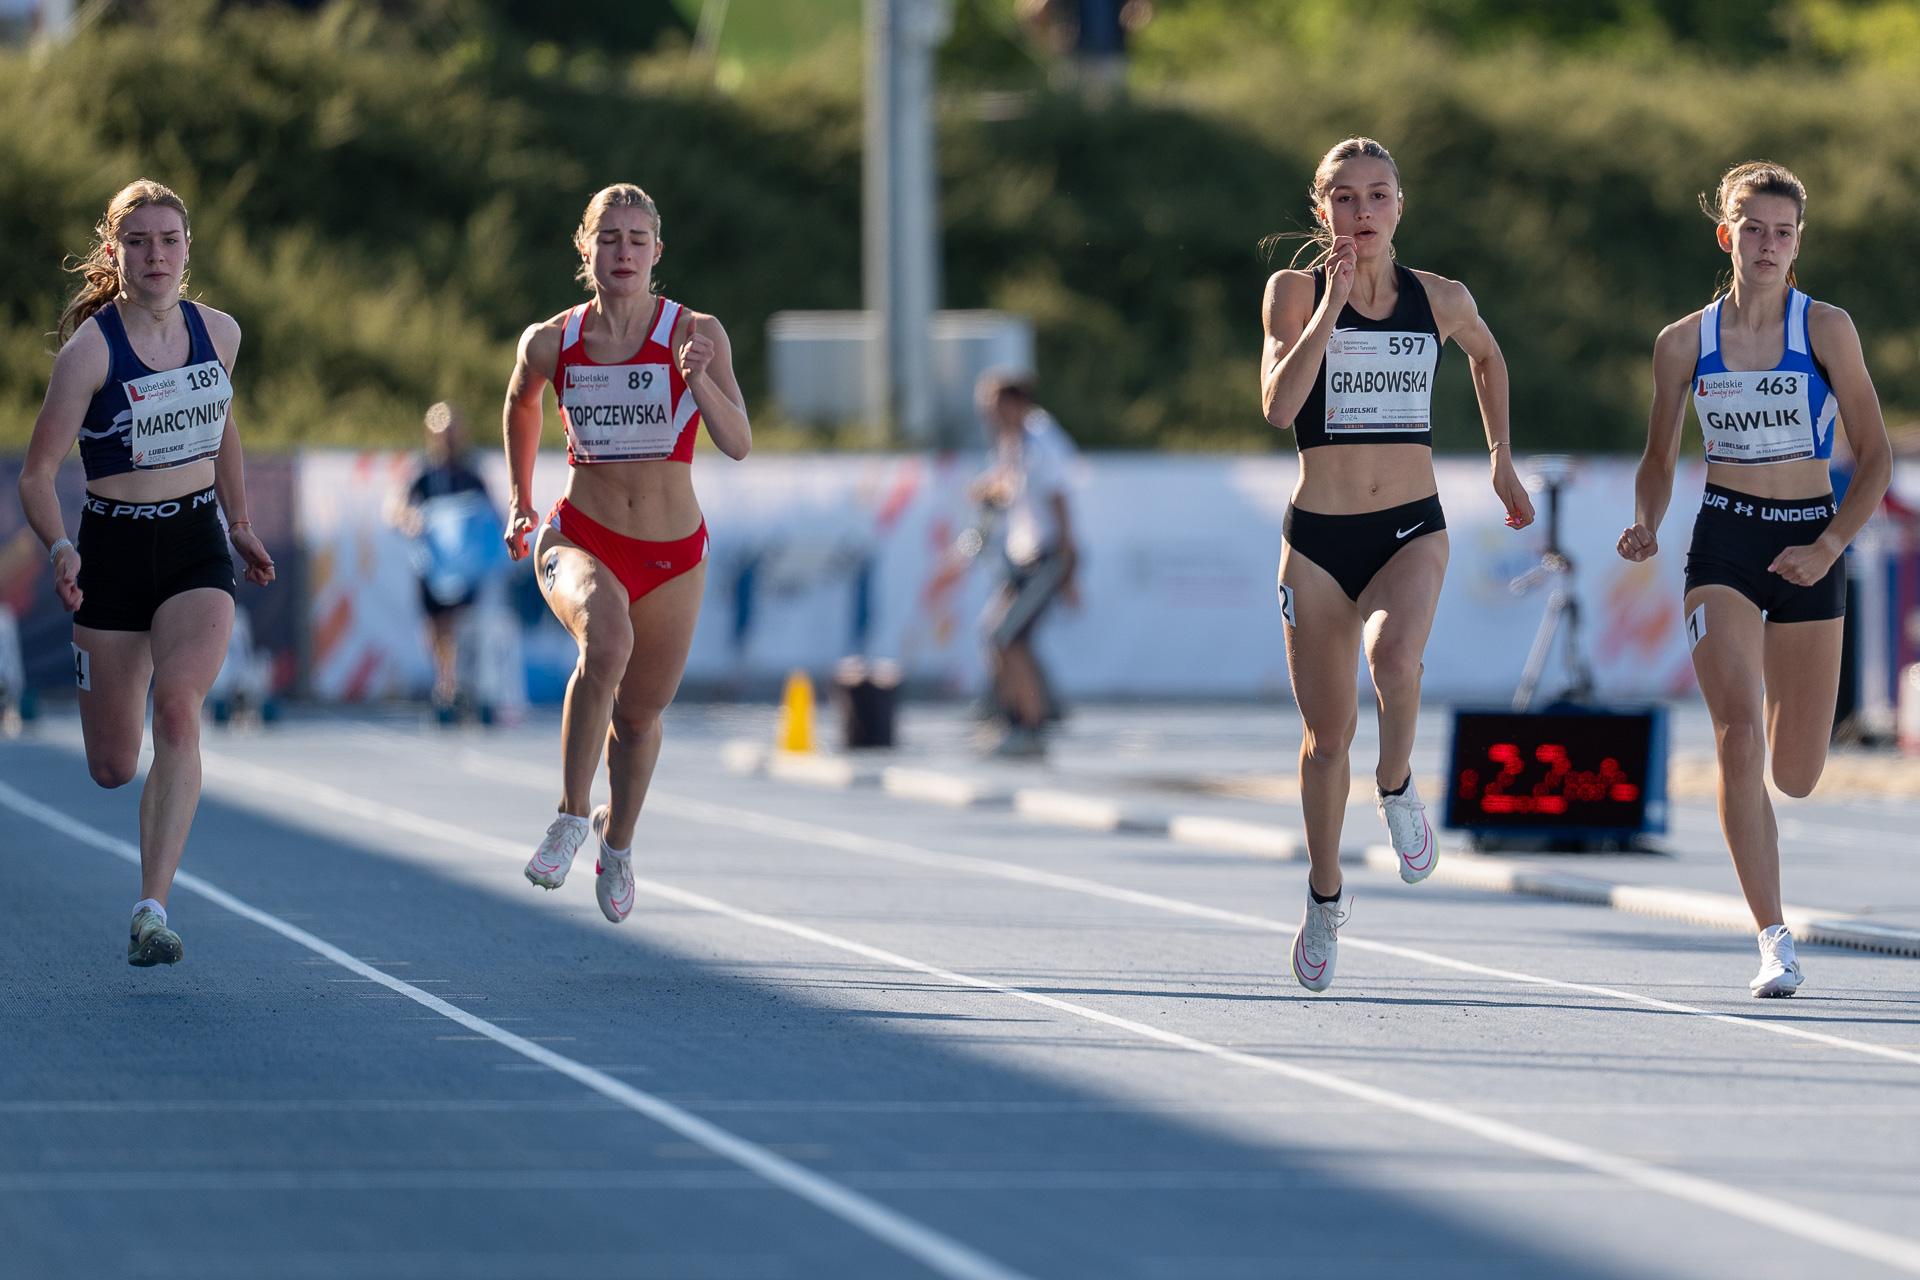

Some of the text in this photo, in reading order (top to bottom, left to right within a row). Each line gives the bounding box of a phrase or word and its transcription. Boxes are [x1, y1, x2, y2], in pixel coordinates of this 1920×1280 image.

[1389, 336, 1426, 356] 597
[186, 366, 219, 391] 189
[628, 370, 654, 390] 89
[1331, 371, 1427, 393] GRABOWSKA
[1756, 376, 1798, 396] 463
[136, 398, 230, 438] MARCYNIUK
[567, 404, 668, 426] TOPCZEWSKA
[1706, 408, 1801, 432] GAWLIK
[148, 444, 184, 456] LUBELSKIE
[1718, 441, 1750, 450] LUBELSKIE
[148, 454, 166, 462] 2024
[112, 502, 180, 520] PRO
[1702, 492, 1828, 522] UR UNDER
[1280, 584, 1290, 621] 2
[1690, 612, 1699, 642] 1
[76, 651, 84, 686] 4
